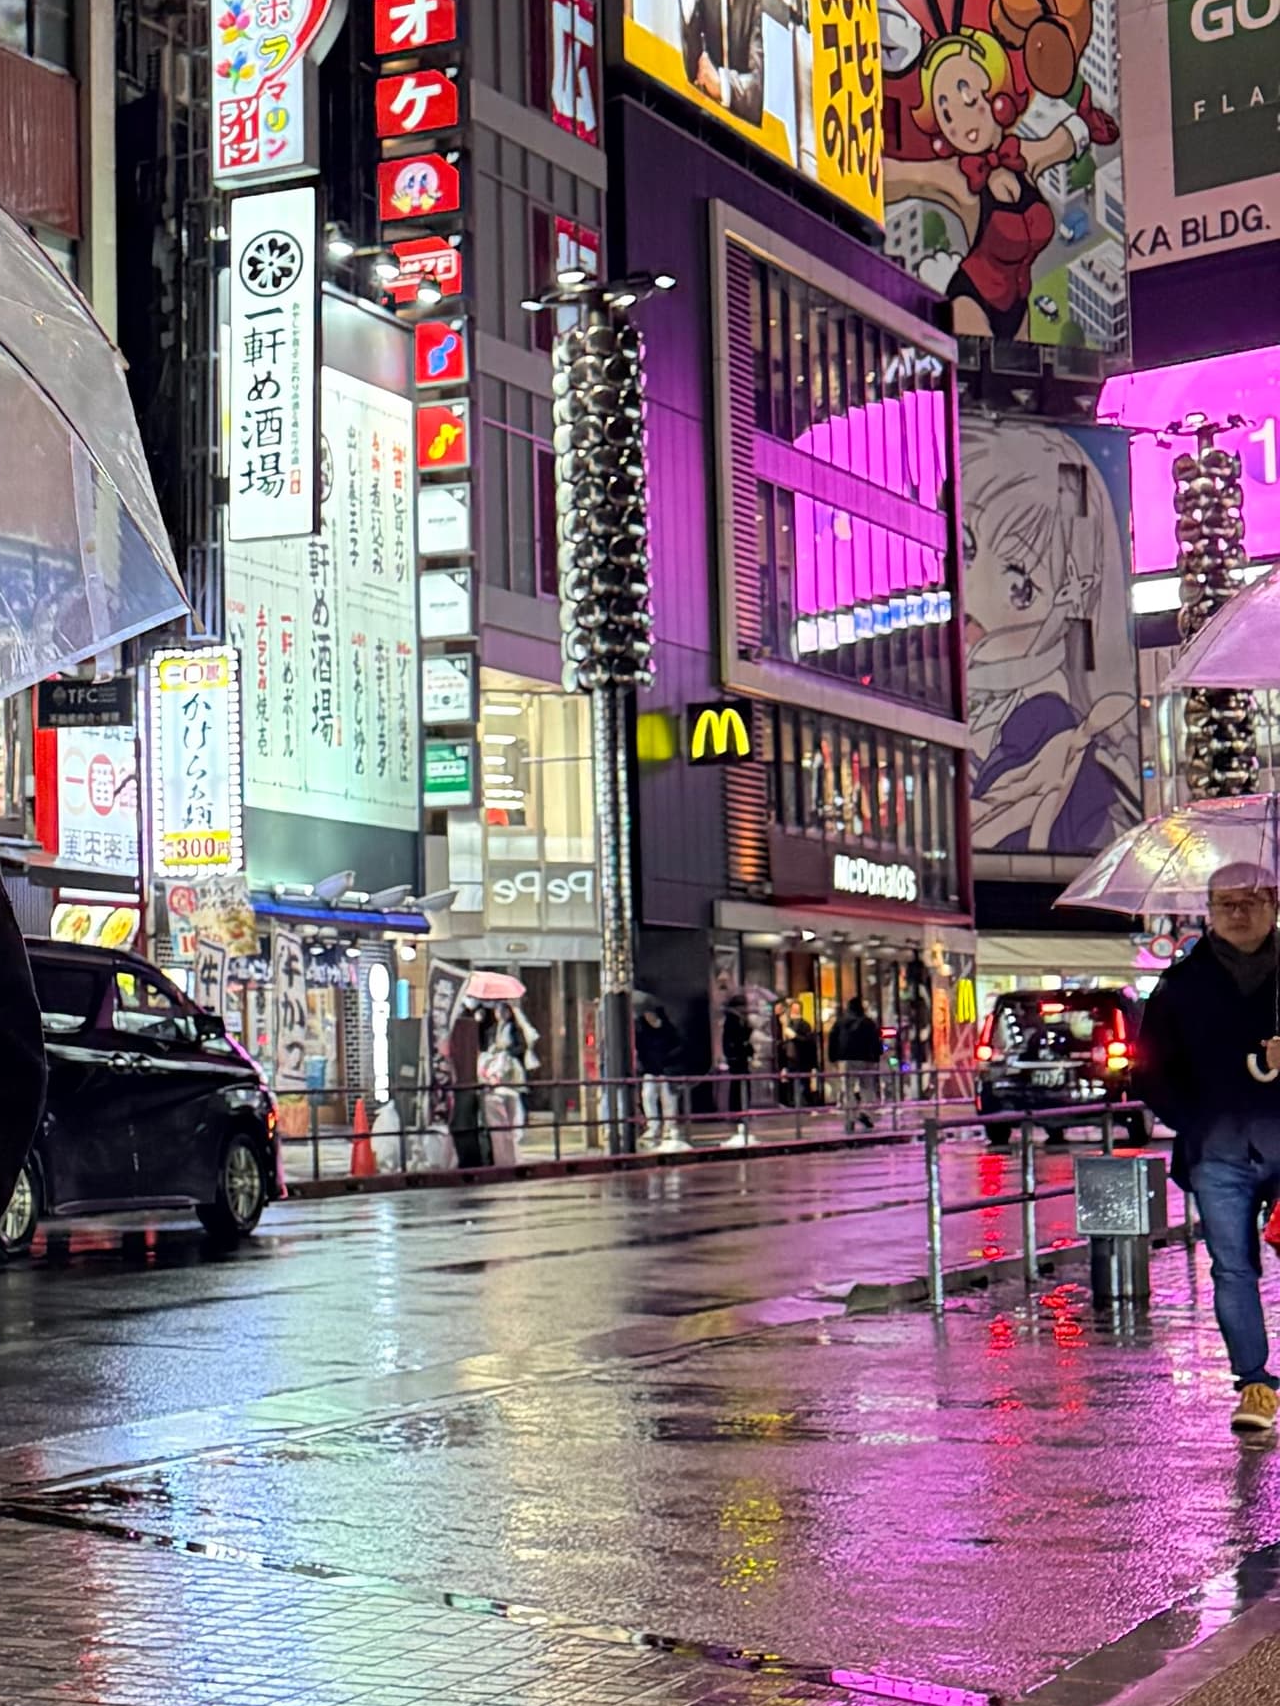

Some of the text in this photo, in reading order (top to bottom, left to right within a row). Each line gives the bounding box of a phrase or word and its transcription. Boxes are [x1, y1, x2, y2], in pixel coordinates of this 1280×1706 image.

[1181, 204, 1271, 248] BLDG.
[239, 306, 287, 499] 一軒め酒場
[308, 519, 334, 749] 軒め酒場
[68, 687, 99, 705] TFC
[833, 854, 918, 902] McDonald's
